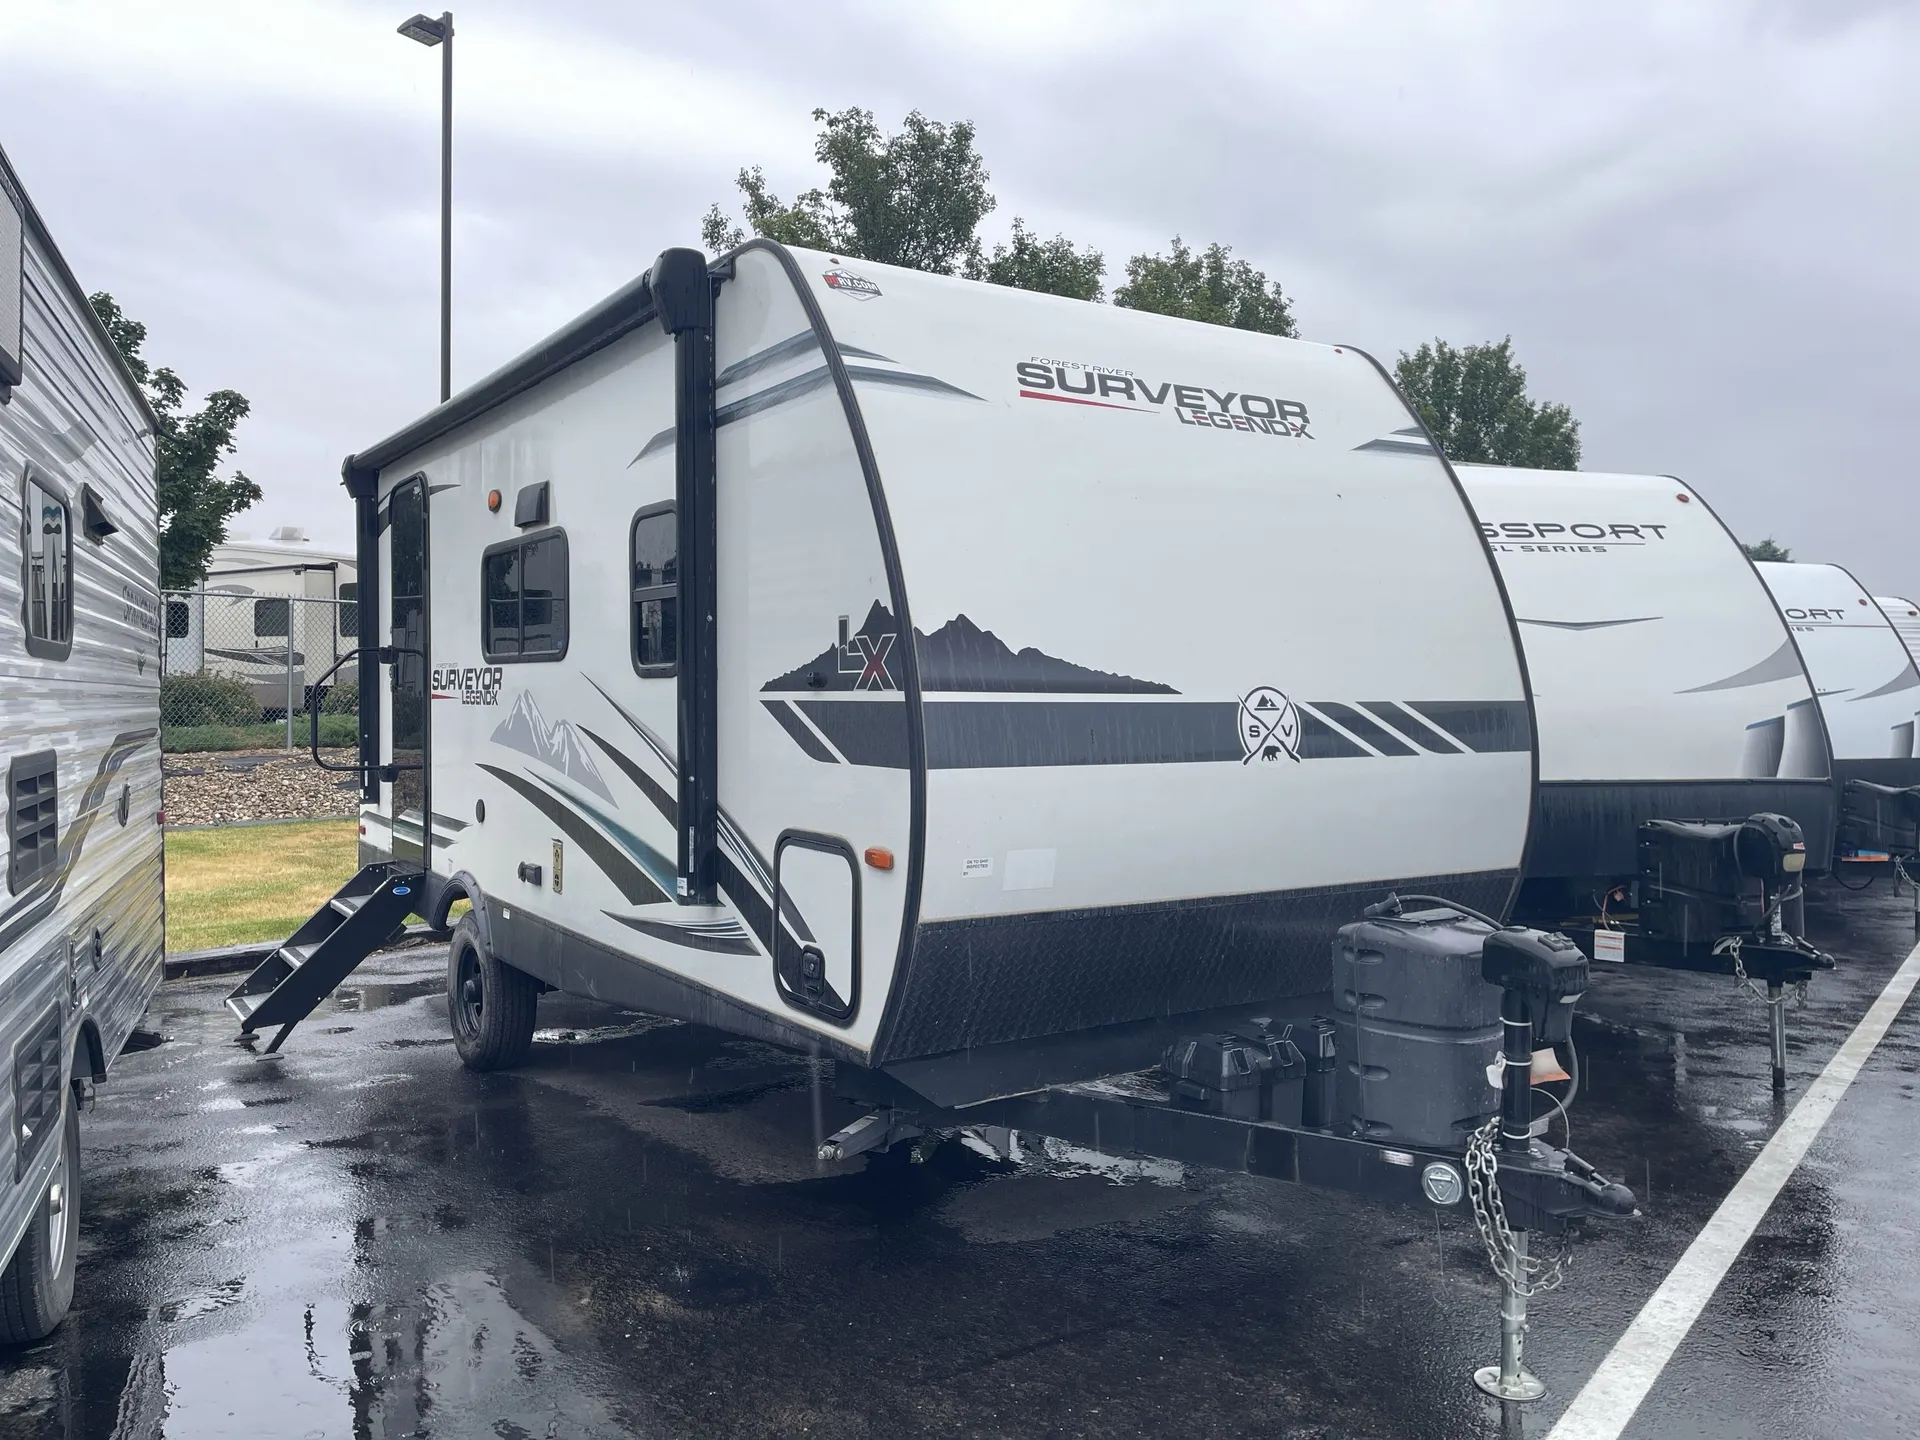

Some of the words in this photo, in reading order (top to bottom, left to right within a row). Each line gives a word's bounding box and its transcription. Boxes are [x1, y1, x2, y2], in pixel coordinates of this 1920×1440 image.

[1030, 356, 1090, 371] FOREST
[1092, 365, 1134, 378] RIVER
[1016, 361, 1311, 425] SURVEYOR
[1520, 545, 1608, 553] SERIES
[1785, 608, 1845, 620] ORT
[432, 667, 503, 691] SURVEYOR
[1249, 725, 1260, 738] S
[1281, 724, 1293, 737] V
